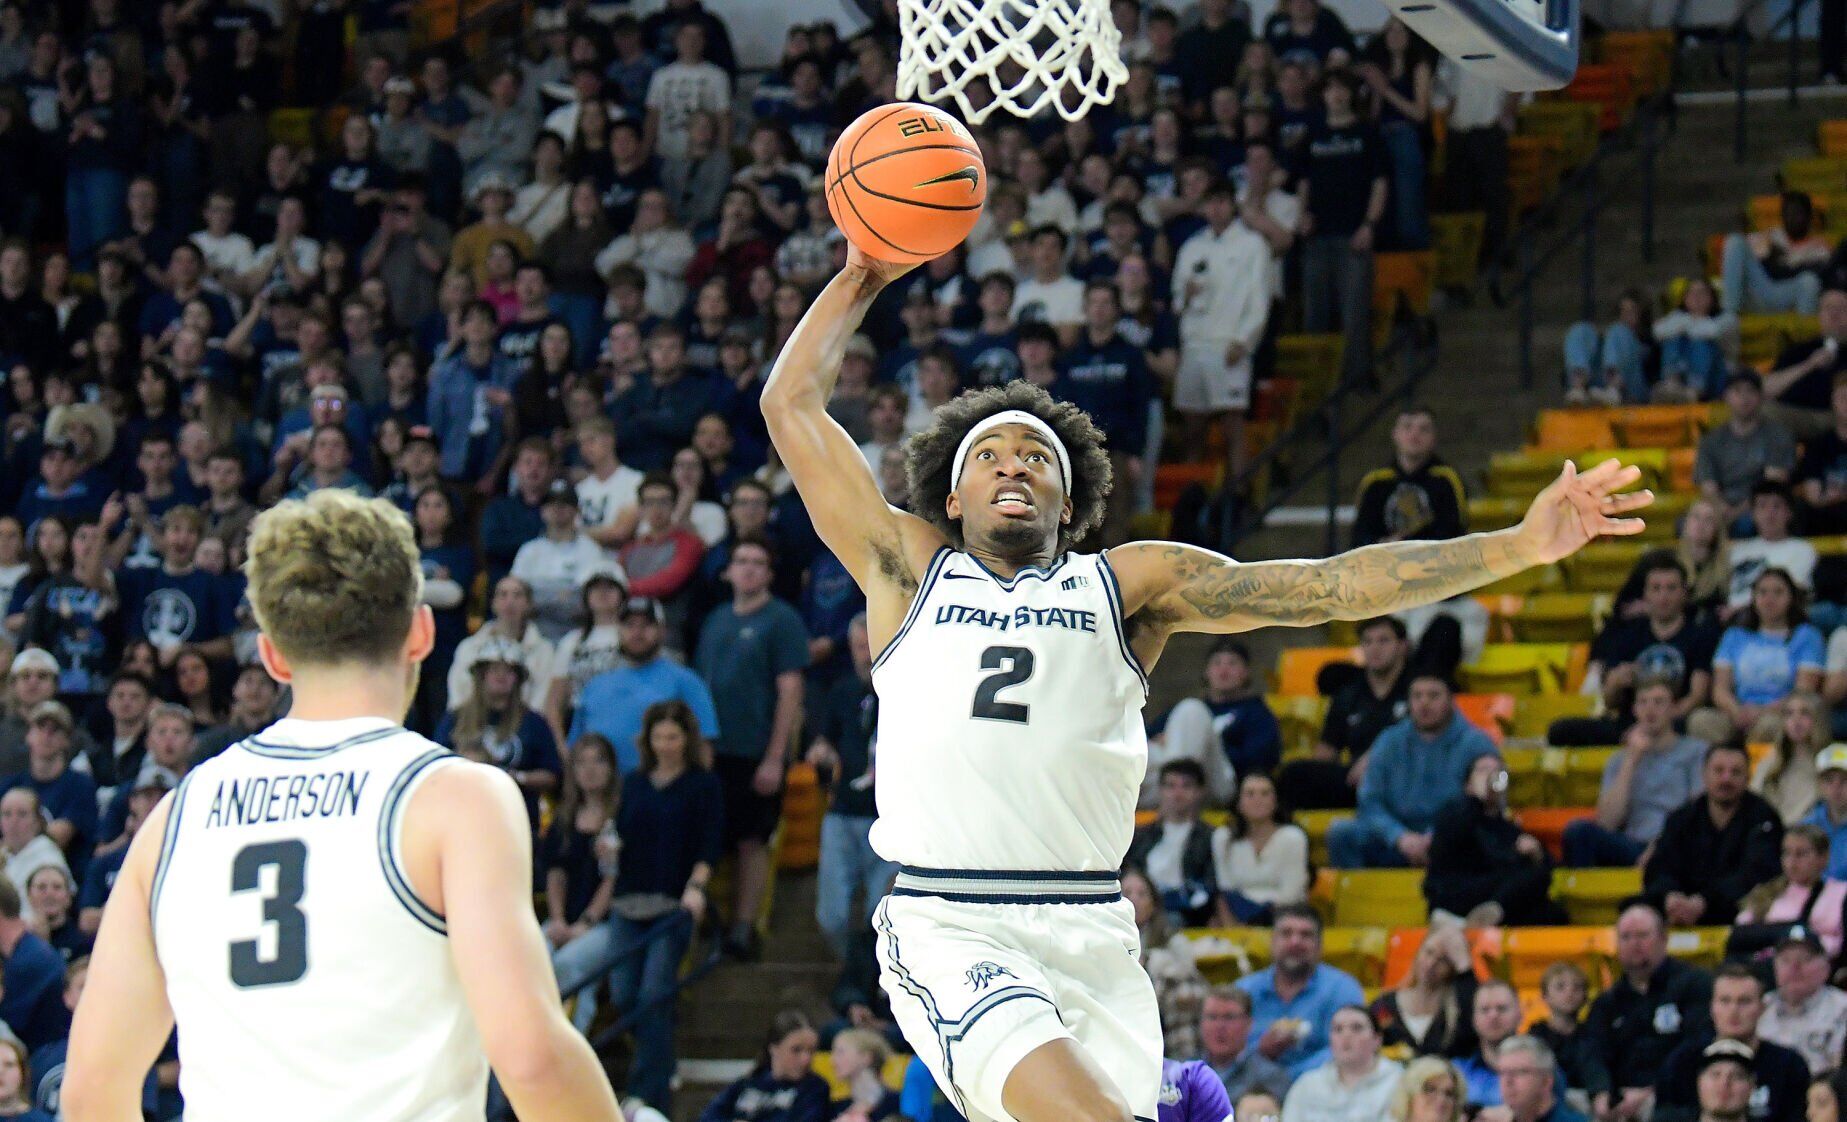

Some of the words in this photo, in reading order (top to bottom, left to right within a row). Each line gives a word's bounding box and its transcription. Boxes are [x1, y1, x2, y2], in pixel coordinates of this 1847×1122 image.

[935, 604, 1011, 632] UTAH
[1014, 605, 1097, 634] STATE
[970, 645, 1036, 725] 2
[206, 770, 370, 829] ANDERSON
[229, 837, 310, 990] 3
